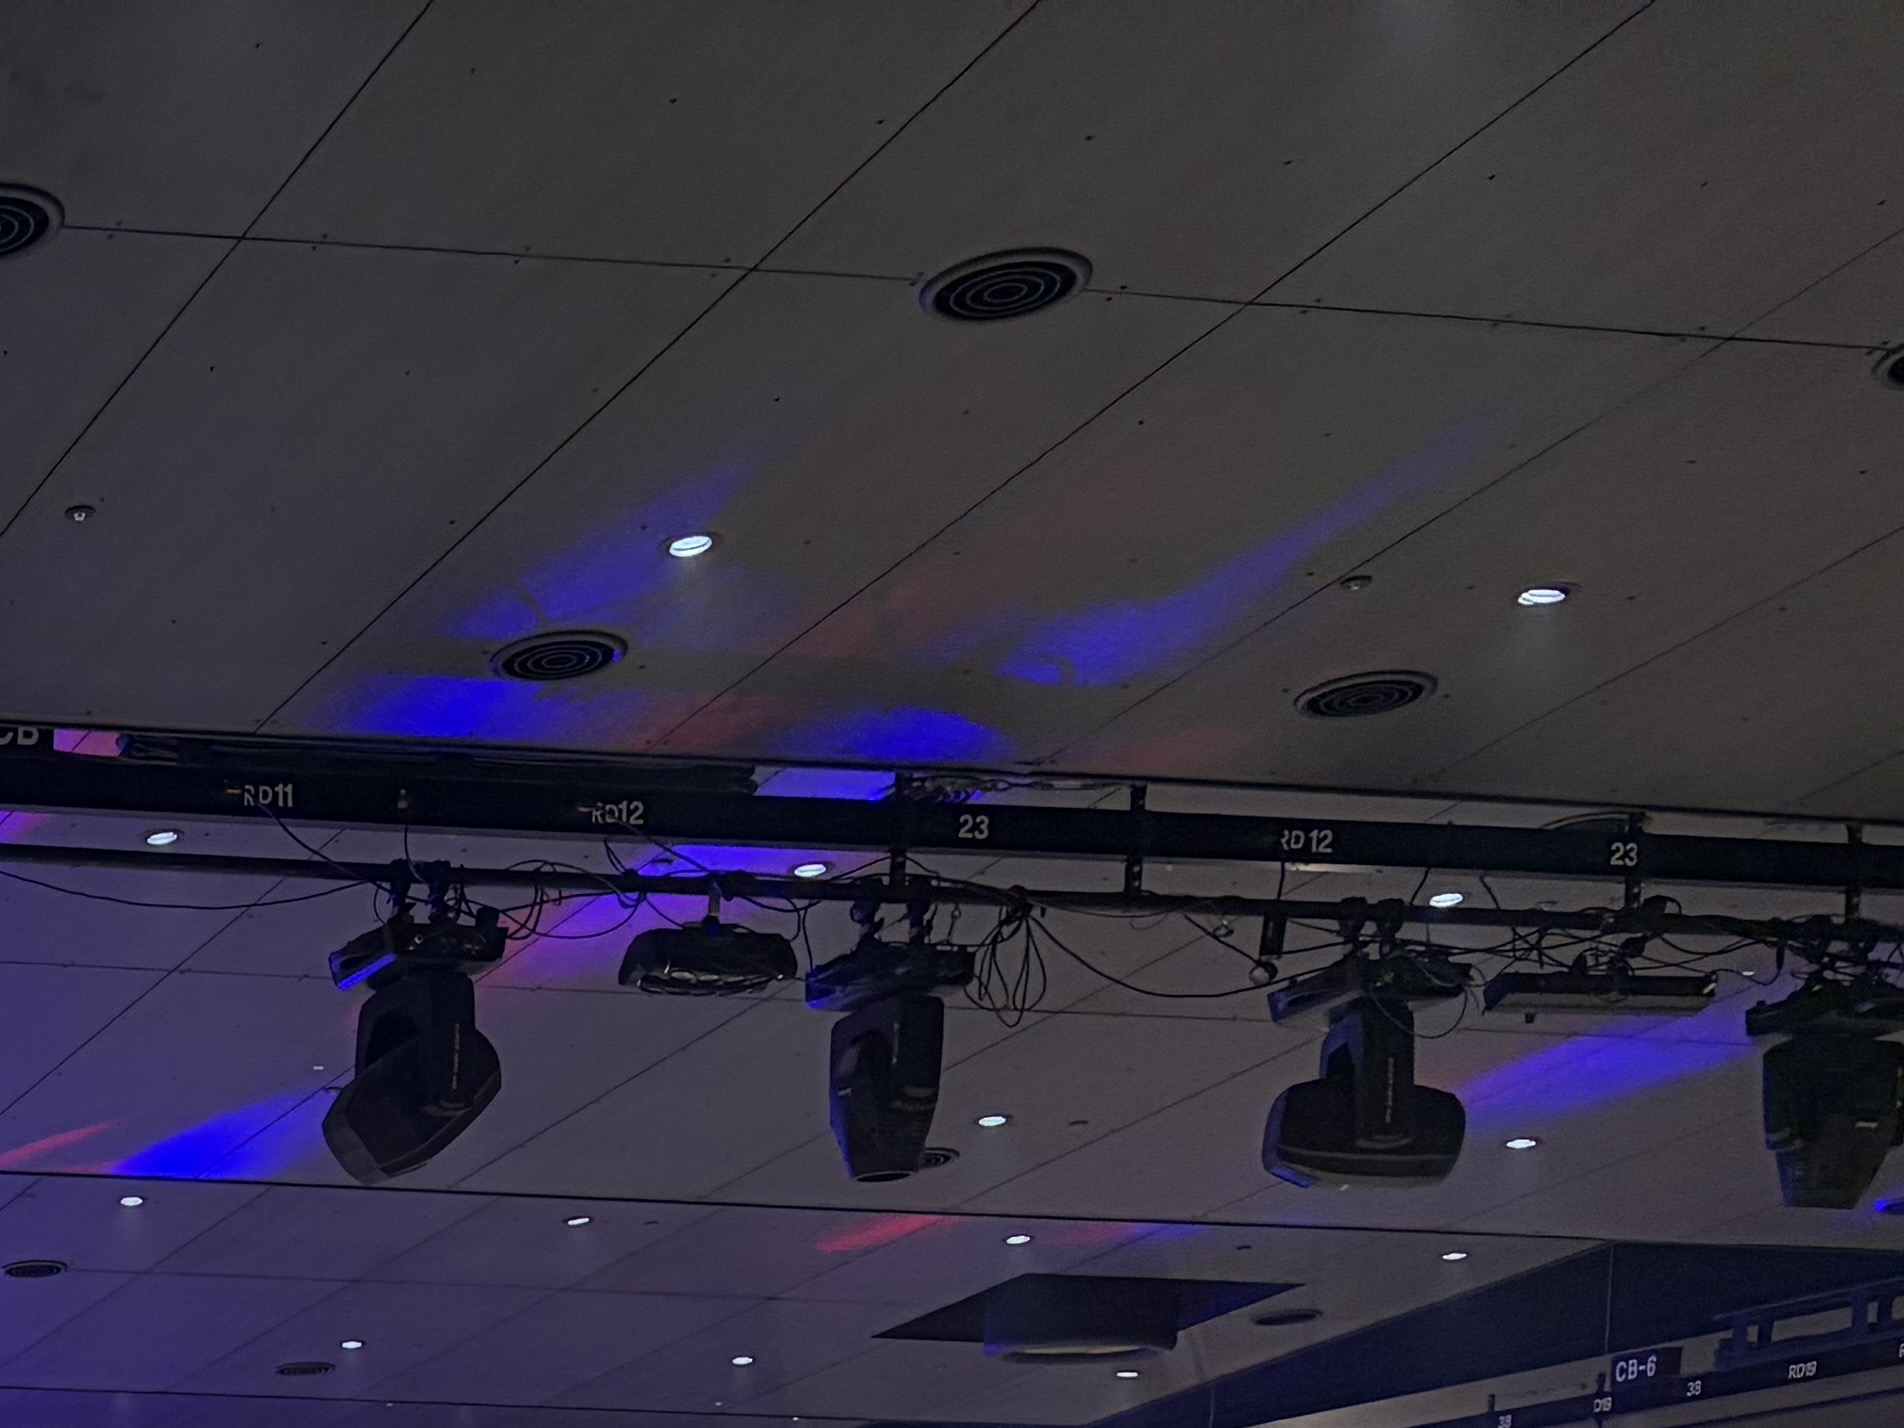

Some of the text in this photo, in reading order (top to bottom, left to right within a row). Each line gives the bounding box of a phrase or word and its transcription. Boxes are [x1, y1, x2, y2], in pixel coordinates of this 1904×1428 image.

[958, 814, 990, 840] 23
[1609, 841, 1639, 868] 23
[1615, 1355, 1658, 1383] CB-6
